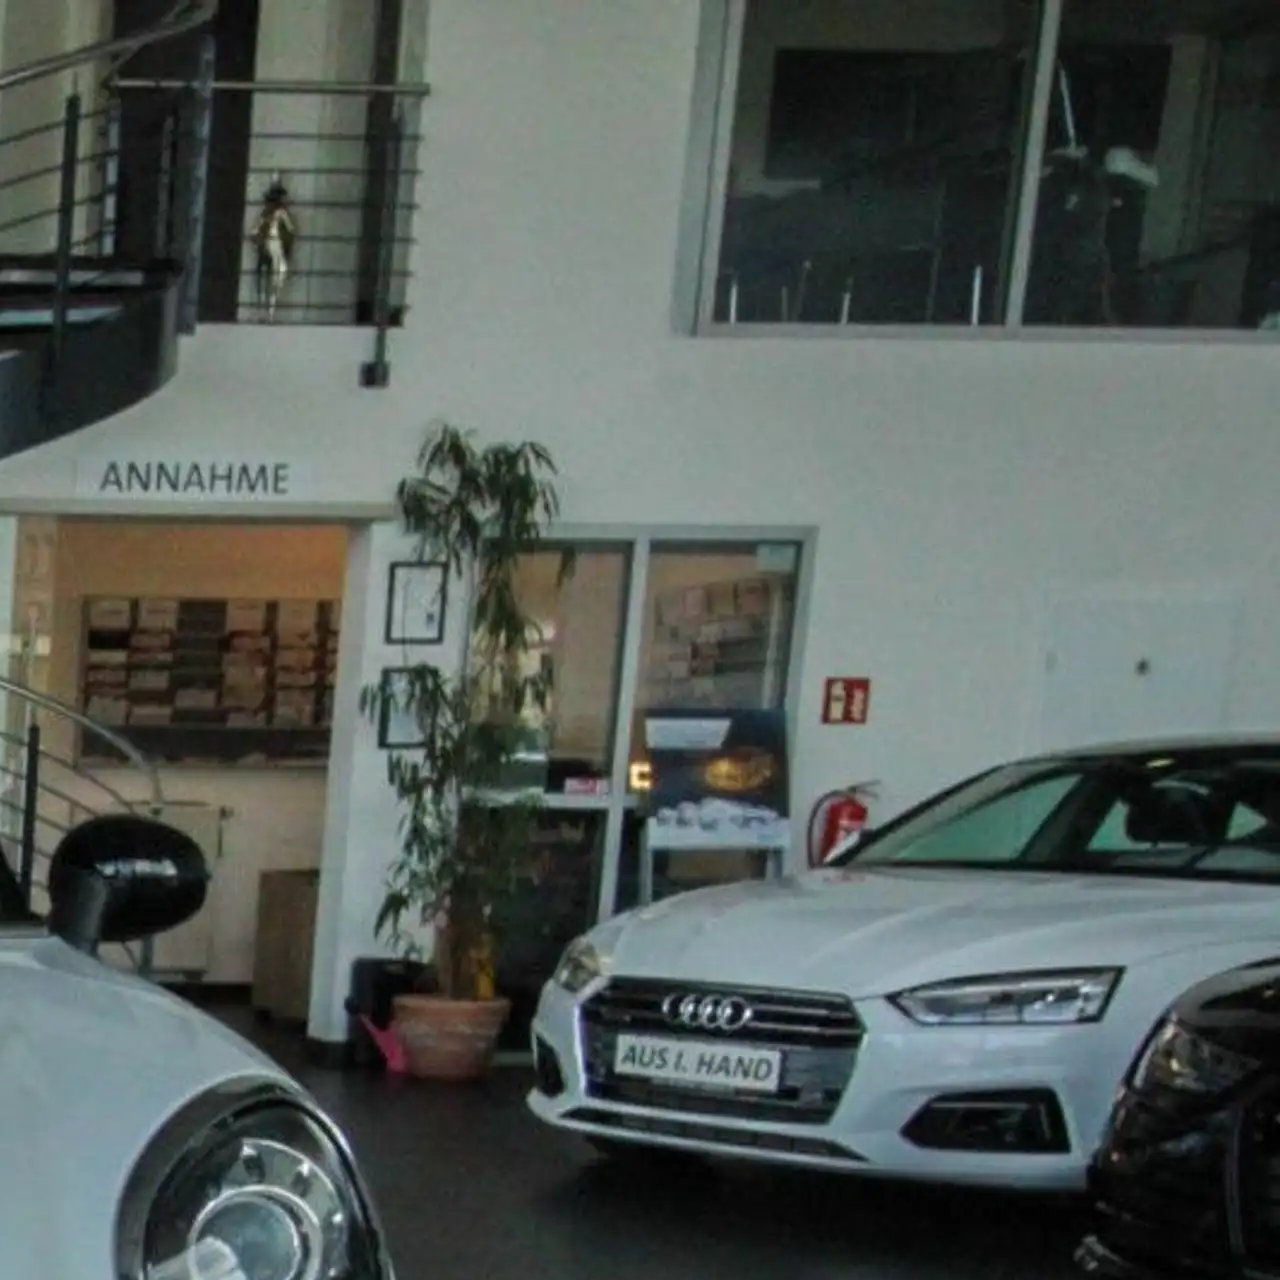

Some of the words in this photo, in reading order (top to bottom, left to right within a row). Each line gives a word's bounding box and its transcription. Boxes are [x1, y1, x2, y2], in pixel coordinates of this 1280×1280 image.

[100, 460, 289, 494] ANNAHME
[621, 1044, 668, 1070] AUS
[695, 1051, 773, 1081] HAND
